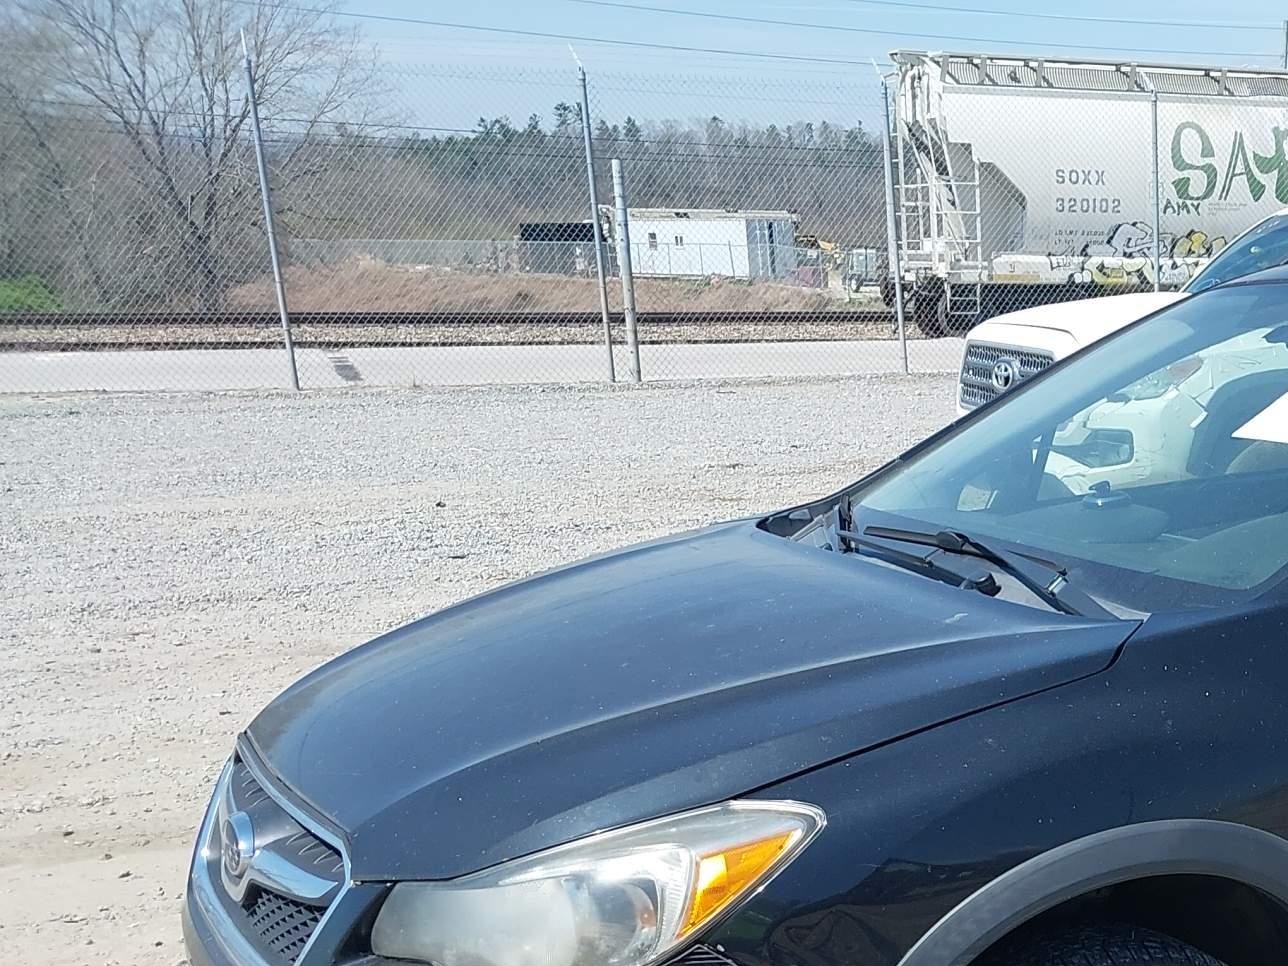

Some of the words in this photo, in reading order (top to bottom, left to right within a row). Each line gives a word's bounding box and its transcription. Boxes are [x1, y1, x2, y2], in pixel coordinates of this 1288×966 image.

[1055, 168, 1106, 185] SOXX
[1055, 197, 1121, 214] 320102
[1163, 198, 1201, 216] AMY
